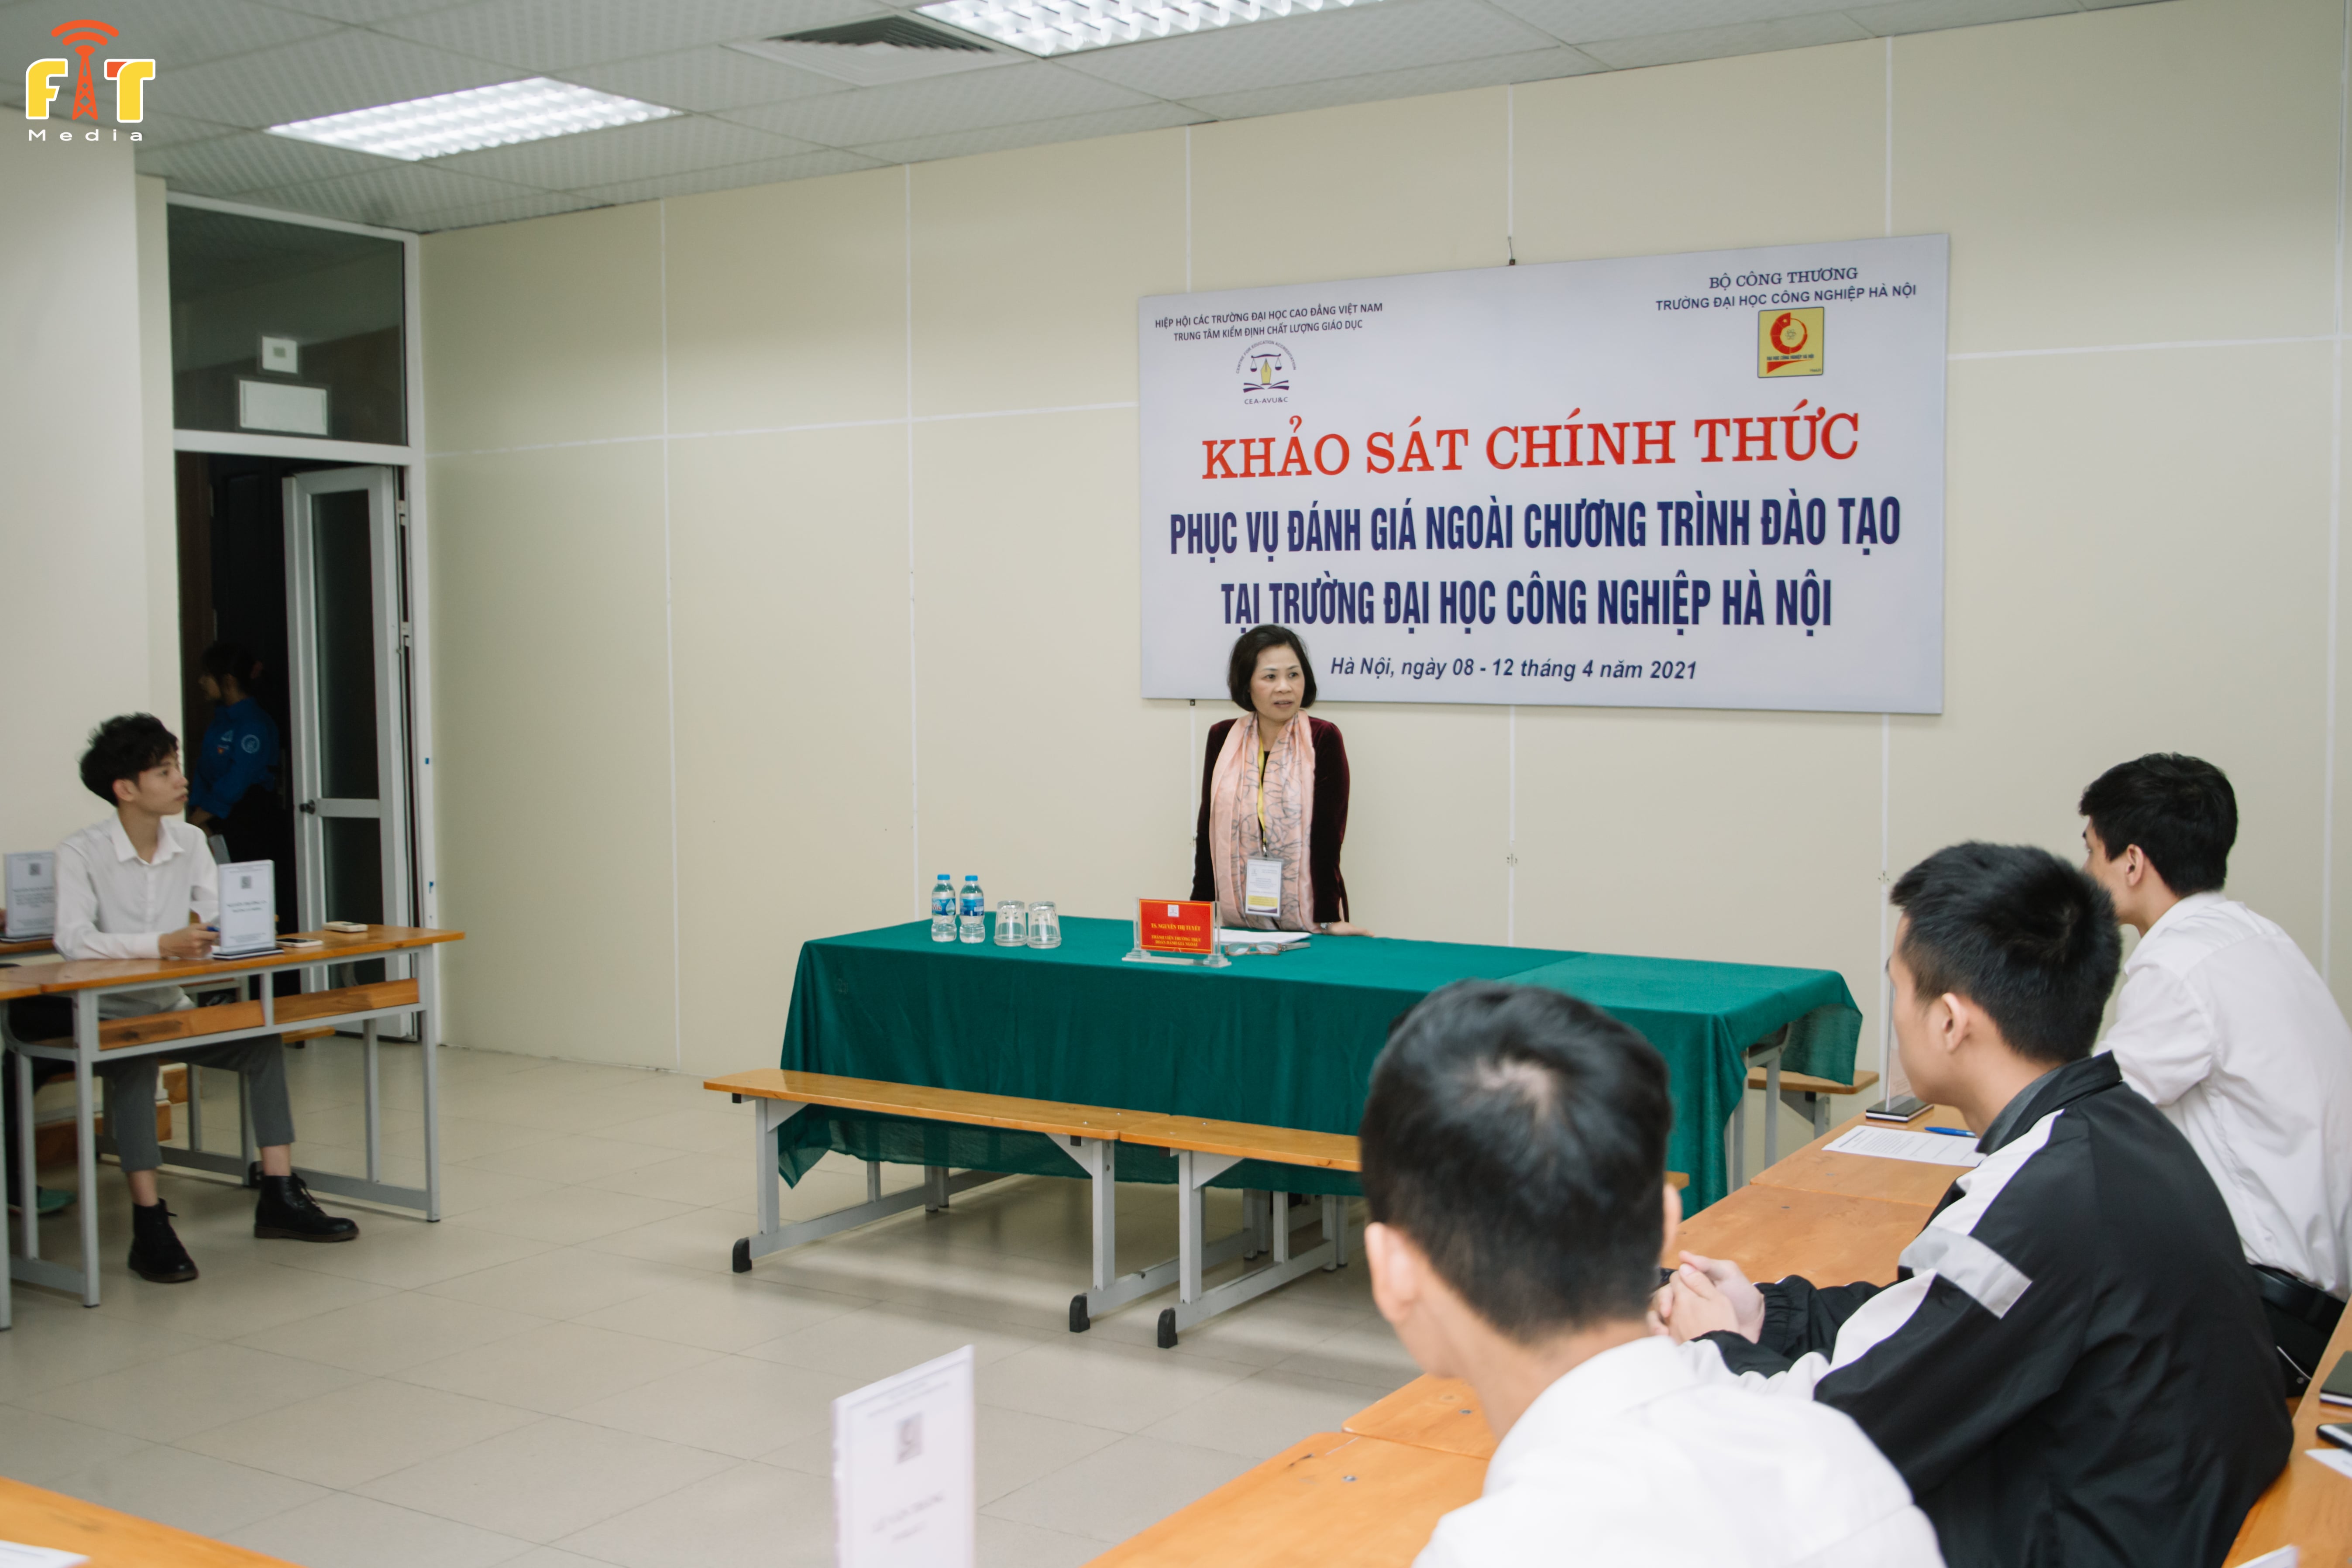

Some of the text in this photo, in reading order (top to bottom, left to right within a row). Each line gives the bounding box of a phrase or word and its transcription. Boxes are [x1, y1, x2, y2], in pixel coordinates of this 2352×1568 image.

[1709, 268, 1858, 290] BỘ CÔNG THƯƠNG
[1656, 282, 1915, 310] TRƯỜNG ĐẠI HỌC CÔNG NGHIỆP HÀ NỘI
[1155, 303, 1382, 329] HIỆP HỘI CÁC TRƯỜNG ĐẠI HỌC CAO ĐẲNG VIỆT NAM
[1174, 320, 1362, 341] TRUNG TÂM KIỂM ĐỊNH CHẤT LƯỢNG GIÁO DỤC
[1203, 399, 1858, 479] KHẢO SÁT CHÍNH THỨC
[1171, 488, 1900, 563] PHỤC VỤ ĐÁNH GIÁ NGOÀI CHƯƠNG TRÌNH ĐÀO TẠO
[1221, 569, 1831, 636] TẠI TRƯỜNG ĐẠI HỌC CÔNG NGHIỆP HÀ NỘI
[1331, 657, 1354, 674] Hà
[1360, 657, 1393, 679] Nội,
[1402, 657, 1447, 680] ngày
[1453, 658, 1474, 675] 08
[1493, 658, 1513, 675] 12
[1521, 659, 1575, 681] tháng
[1582, 660, 1593, 677] 4
[1600, 660, 1642, 678] năm
[1650, 661, 1696, 679] 2021
